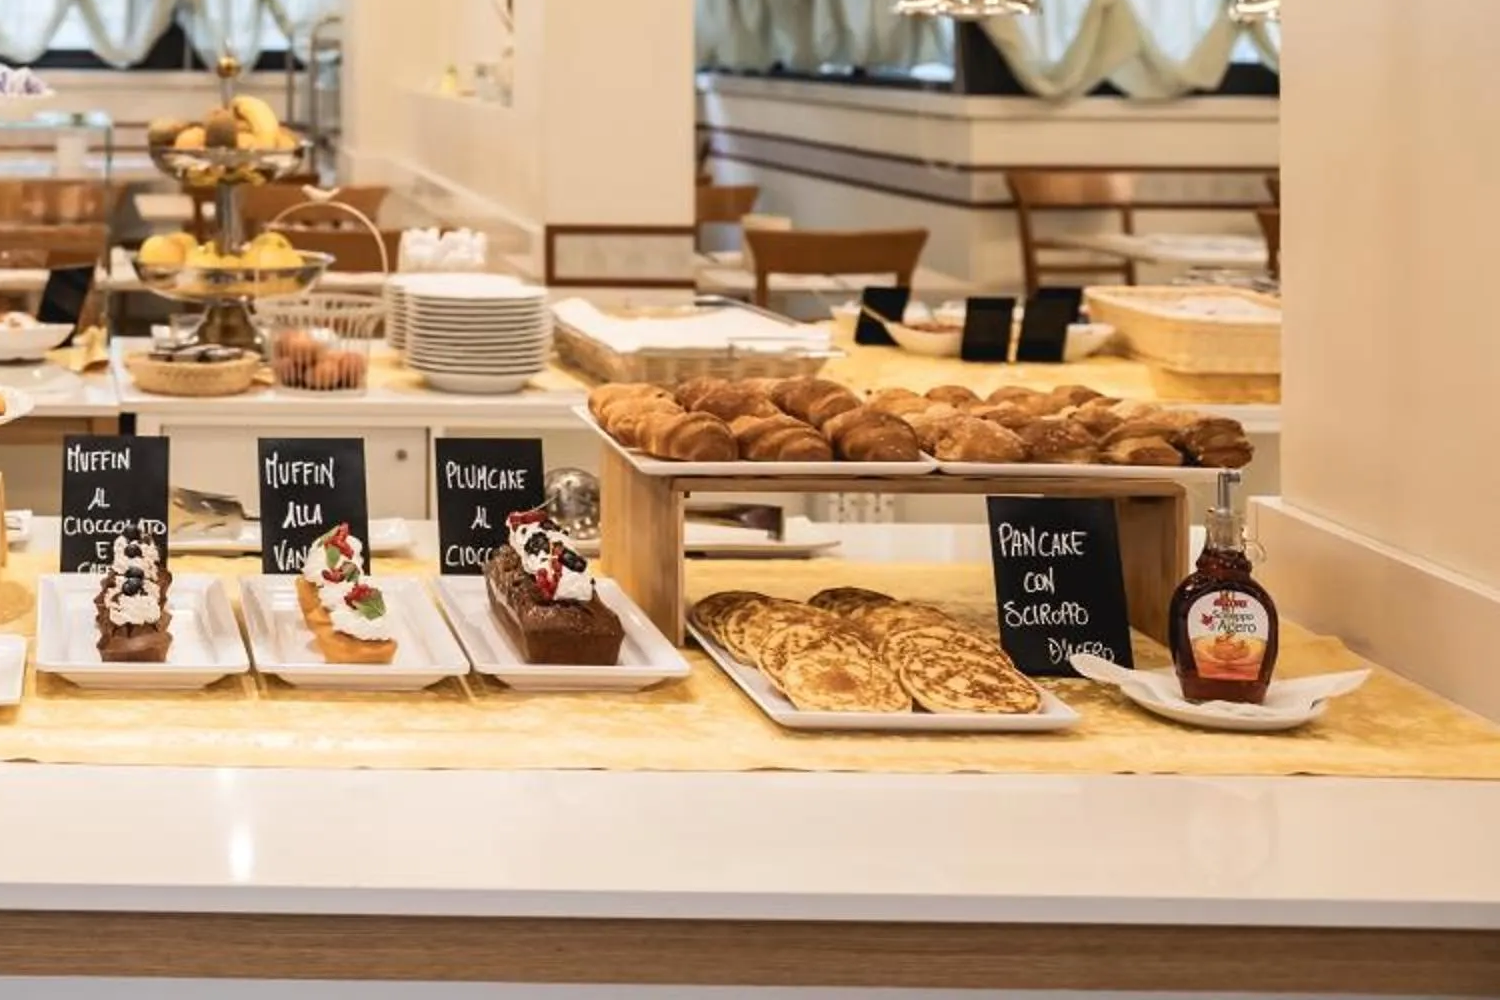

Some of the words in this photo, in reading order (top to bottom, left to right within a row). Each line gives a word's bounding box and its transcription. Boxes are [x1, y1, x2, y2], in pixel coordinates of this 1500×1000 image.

[67, 443, 131, 473] MUFFIN
[265, 451, 335, 489] MUFFIN
[445, 460, 527, 491] PLUMCAKE
[87, 487, 111, 511] AL
[281, 501, 323, 529] ALLA
[470, 505, 492, 530] AL
[94, 540, 112, 560] E
[998, 522, 1086, 557] PANCAKE
[1023, 566, 1055, 593] CON
[1003, 600, 1089, 627] SCIROPPO
